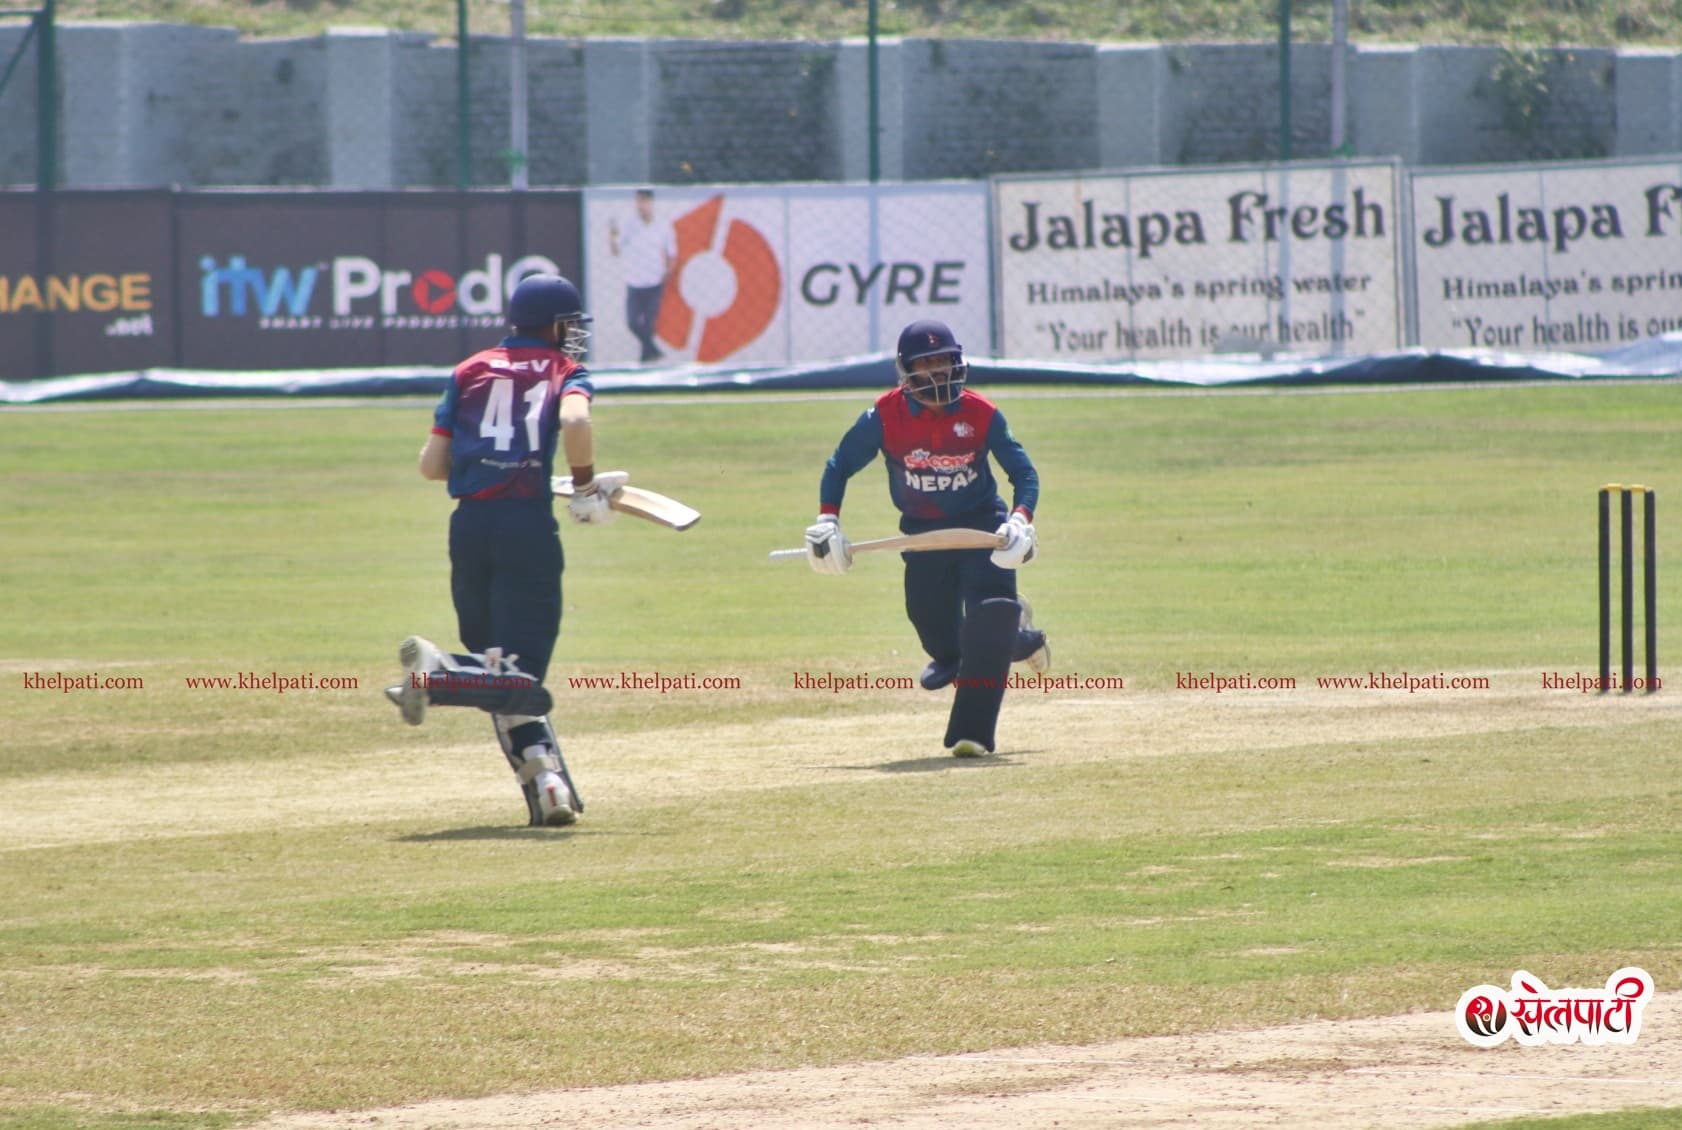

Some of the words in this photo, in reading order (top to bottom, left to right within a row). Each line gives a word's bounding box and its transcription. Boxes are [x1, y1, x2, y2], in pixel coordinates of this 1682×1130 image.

[1009, 199, 1206, 259] Jalapa
[1227, 186, 1385, 243] Fresh
[1423, 191, 1623, 253] Jalapa
[1645, 183, 1682, 237] F
[200, 255, 318, 317] itw
[801, 261, 965, 306] GYRE
[1027, 275, 1185, 307] Himalaya's
[1194, 274, 1286, 302] spring
[1292, 272, 1373, 294] water
[1443, 269, 1602, 301] Himalaya's
[1116, 316, 1192, 349] health
[1201, 318, 1220, 347] is
[1532, 313, 1609, 346] health
[1619, 312, 1640, 341] is
[480, 379, 550, 451] 41
[905, 468, 979, 492] NEPAL
